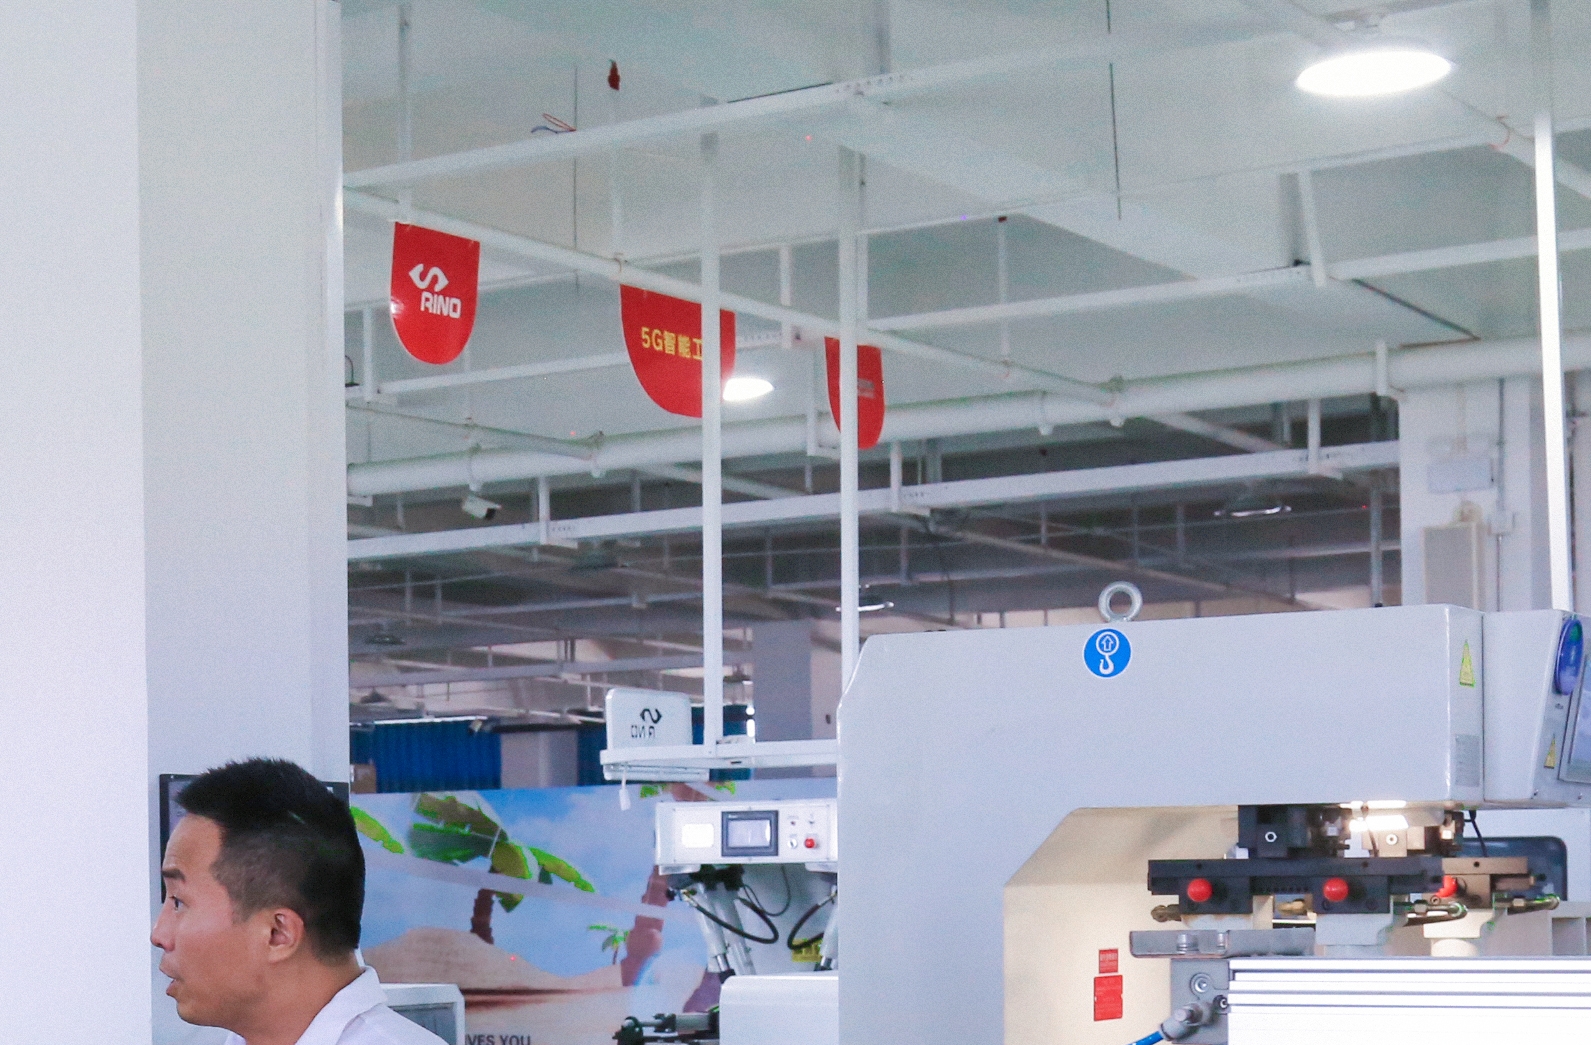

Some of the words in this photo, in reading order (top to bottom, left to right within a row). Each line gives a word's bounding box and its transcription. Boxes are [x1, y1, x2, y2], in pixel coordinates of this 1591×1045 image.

[420, 291, 462, 319] RINO
[641, 326, 702, 361] 5G智能工
